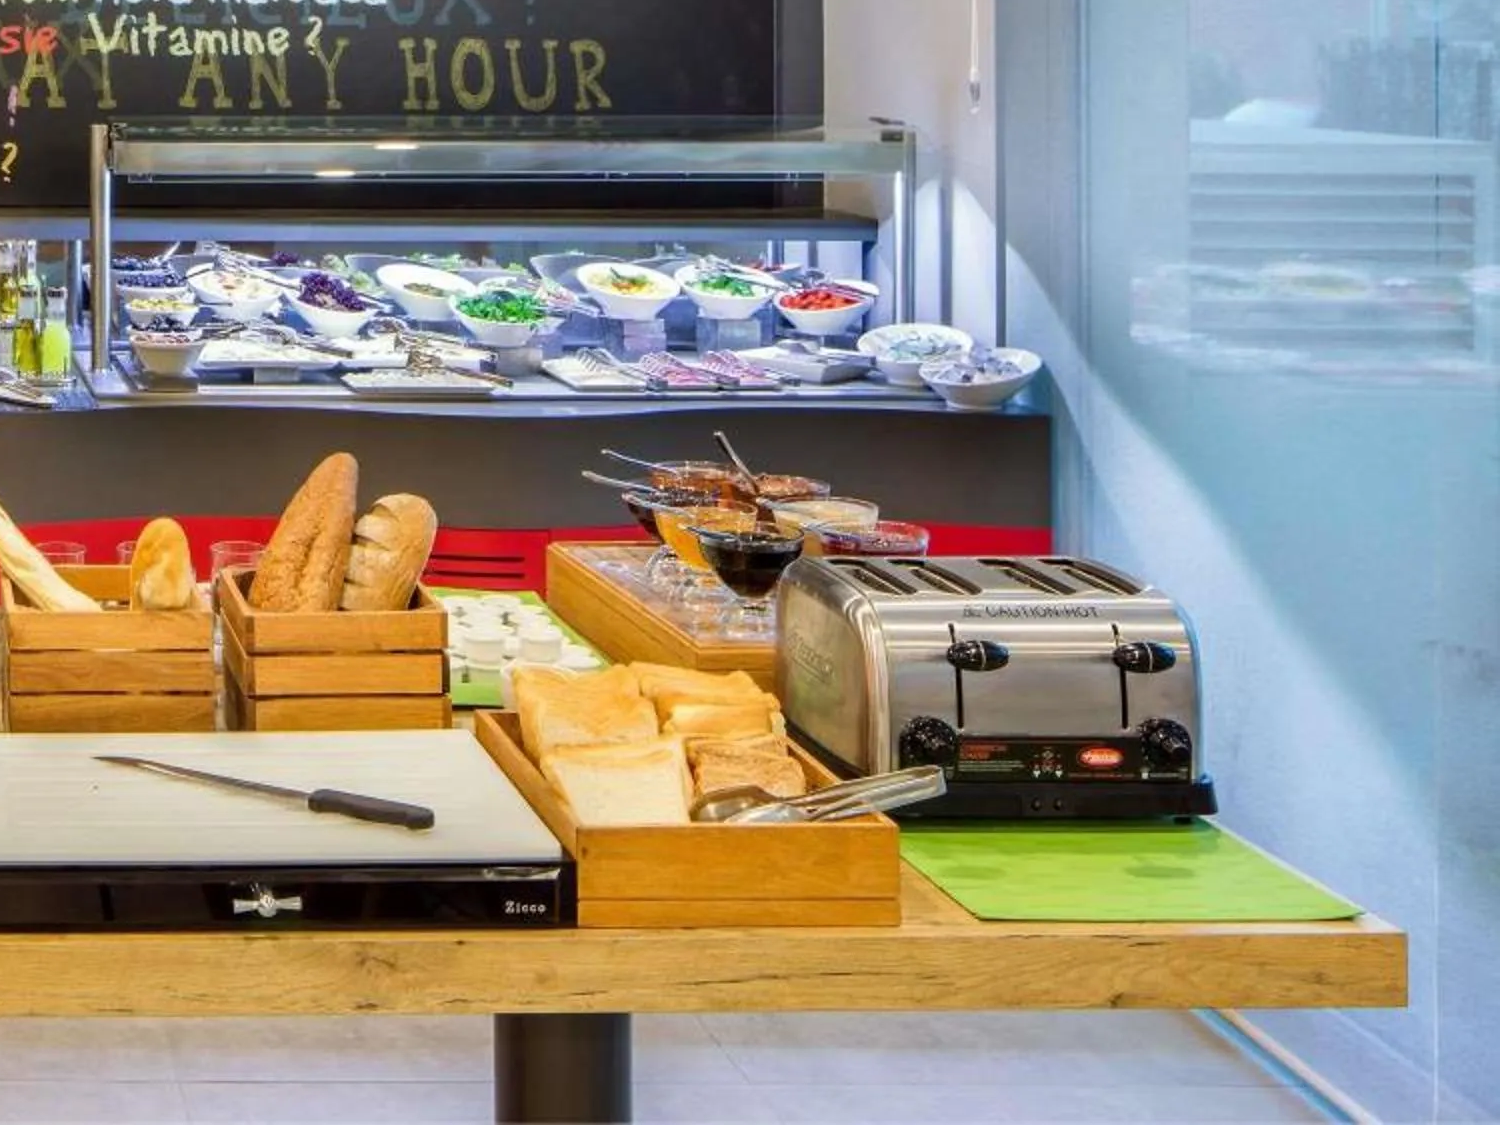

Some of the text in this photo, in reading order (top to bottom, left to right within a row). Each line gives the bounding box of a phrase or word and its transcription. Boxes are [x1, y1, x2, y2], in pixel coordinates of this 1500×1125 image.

[87, 11, 290, 57] Vitamine
[179, 38, 349, 109] ANY
[399, 37, 612, 111] HOUR
[505, 900, 547, 914] Zicco
